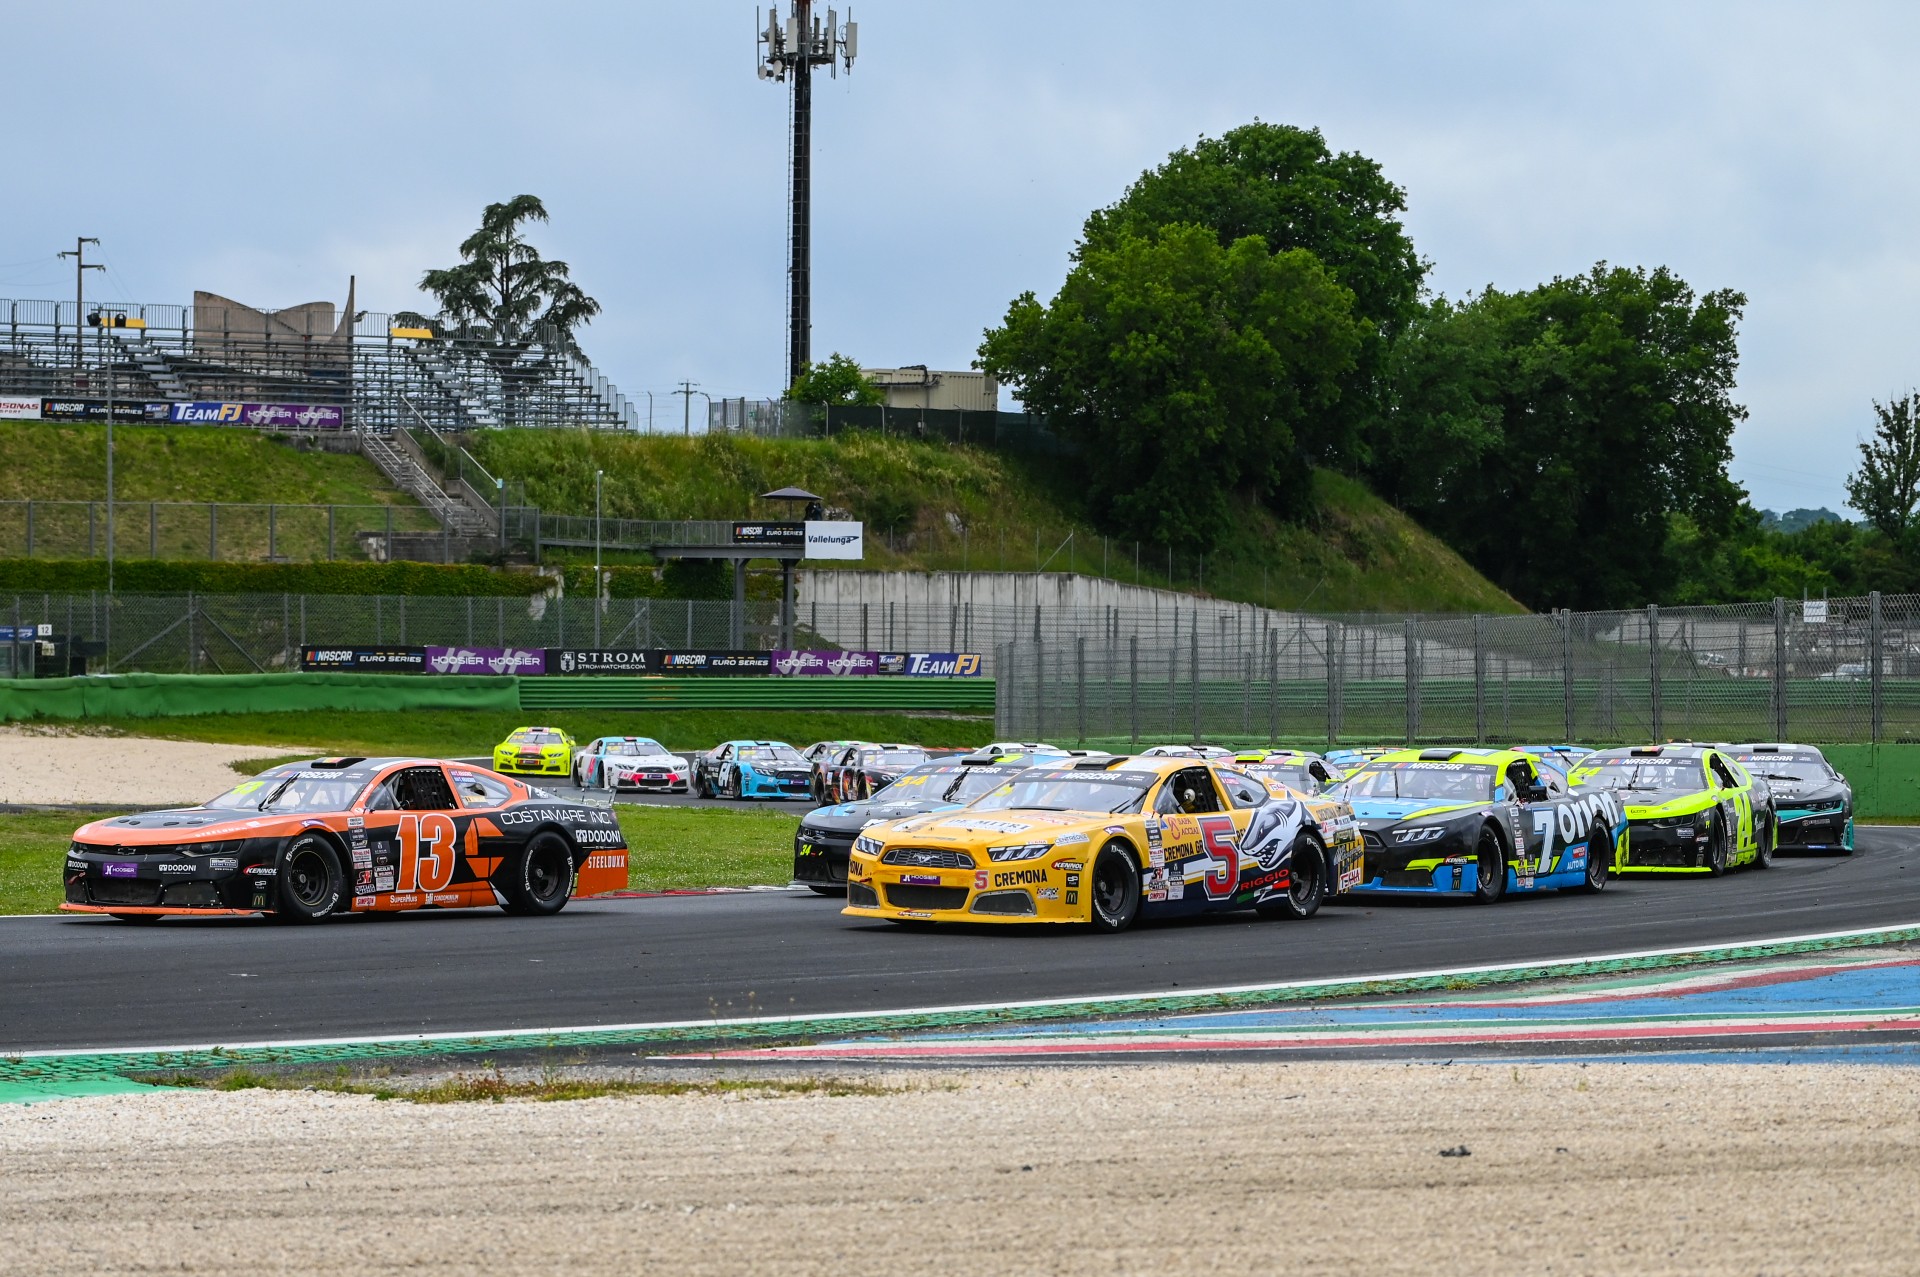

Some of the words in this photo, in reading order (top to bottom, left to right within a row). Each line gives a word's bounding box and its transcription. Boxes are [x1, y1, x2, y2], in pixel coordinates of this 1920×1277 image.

[54, 403, 85, 412] NASCAR
[247, 410, 292, 419] HOOSIER
[295, 411, 339, 420] HOOSIER
[808, 535, 851, 545] Vallelunga
[41, 626, 49, 634] 12
[317, 651, 353, 662] NASCAR
[431, 656, 484, 665] HOOSIER
[488, 657, 541, 666] HOOSIER
[577, 653, 646, 663] STROM
[674, 655, 707, 664] NASCAR
[738, 659, 769, 667] SERIES
[776, 658, 824, 667] HOOSIER
[827, 659, 874, 667] HOOSIER
[1408, 763, 1465, 771] NASCAR
[894, 775, 929, 787] 34
[1061, 772, 1121, 781] NASCAR
[500, 809, 587, 825] COSTAMARE
[589, 811, 613, 824] INC.
[588, 830, 621, 843] DODONI
[1533, 807, 1555, 874] 7
[395, 814, 457, 893] 13
[800, 844, 812, 856] 34
[1164, 842, 1194, 861] CREMONA
[1196, 815, 1239, 901] 5
[168, 864, 196, 872] DODONI
[1054, 861, 1083, 870] KENNOL
[974, 870, 990, 890] 5
[994, 868, 1048, 887] CREMONA
[1240, 869, 1289, 891] RIGGIO
